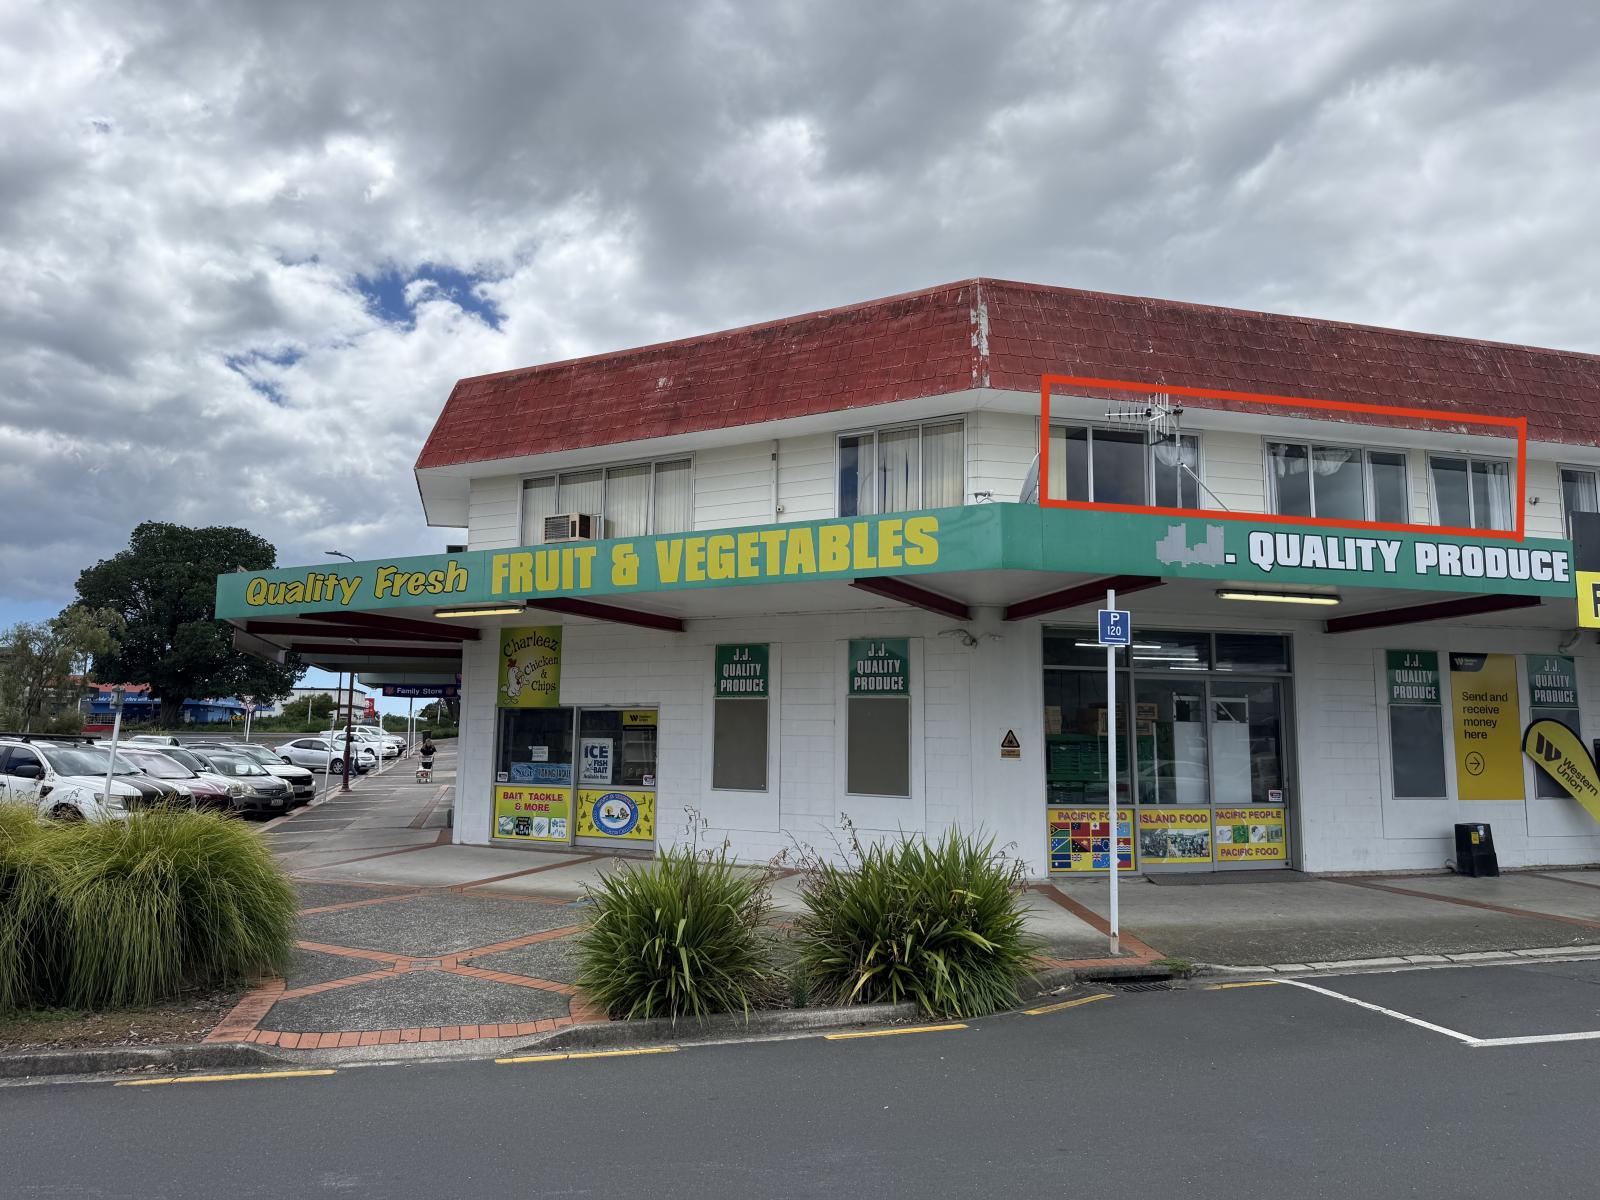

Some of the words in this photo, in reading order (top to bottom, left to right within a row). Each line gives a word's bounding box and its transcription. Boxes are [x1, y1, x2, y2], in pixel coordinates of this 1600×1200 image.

[246, 572, 362, 606] Quality
[374, 560, 468, 599] Fresh
[491, 544, 597, 595] FRUIT
[611, 543, 639, 586] &
[655, 516, 940, 584] VEGETABLES
[1248, 531, 1402, 573] QUALITY
[1415, 541, 1570, 583] PRODUCE
[1110, 612, 1120, 625] P
[1107, 625, 1122, 636] 120
[503, 631, 559, 657] Charleez
[867, 643, 889, 657] J.J.
[733, 648, 752, 661] J.J.
[1404, 654, 1422, 667] J.J.
[524, 656, 559, 675] Chicken
[723, 663, 762, 678] QUALITY
[857, 659, 901, 674] QUALITY
[1543, 659, 1560, 672] J.J.
[854, 676, 904, 690] PRODUCE
[1395, 670, 1432, 684] QUALITY
[1535, 675, 1569, 688] QUALITY
[396, 687, 420, 695] Family
[531, 680, 556, 695] Chips
[720, 679, 764, 692] PRODUCE
[1393, 685, 1436, 699] PRODUCE
[1462, 691, 1488, 702] Send
[1489, 691, 1508, 702] and
[1534, 689, 1574, 703] PRODUCE
[1463, 704, 1499, 714] receive
[1464, 717, 1497, 728] money
[1464, 729, 1488, 739] here
[583, 745, 609, 759] ICE
[593, 759, 608, 767] FISH
[593, 766, 608, 774] BAIT
[1556, 764, 1584, 793] Union
[1562, 757, 1599, 797] Western
[503, 791, 524, 800] BAIT
[528, 792, 564, 802] TACKLE
[524, 803, 550, 812] MORE
[1057, 811, 1097, 821] PACIFIC
[1140, 813, 1177, 823] ISLAND
[1180, 813, 1208, 823] FOOD
[1215, 810, 1247, 820] PACIFIC
[1248, 810, 1281, 819] PEOPLE
[1221, 848, 1254, 857] PACIFIC
[1255, 847, 1279, 856] FOOD
